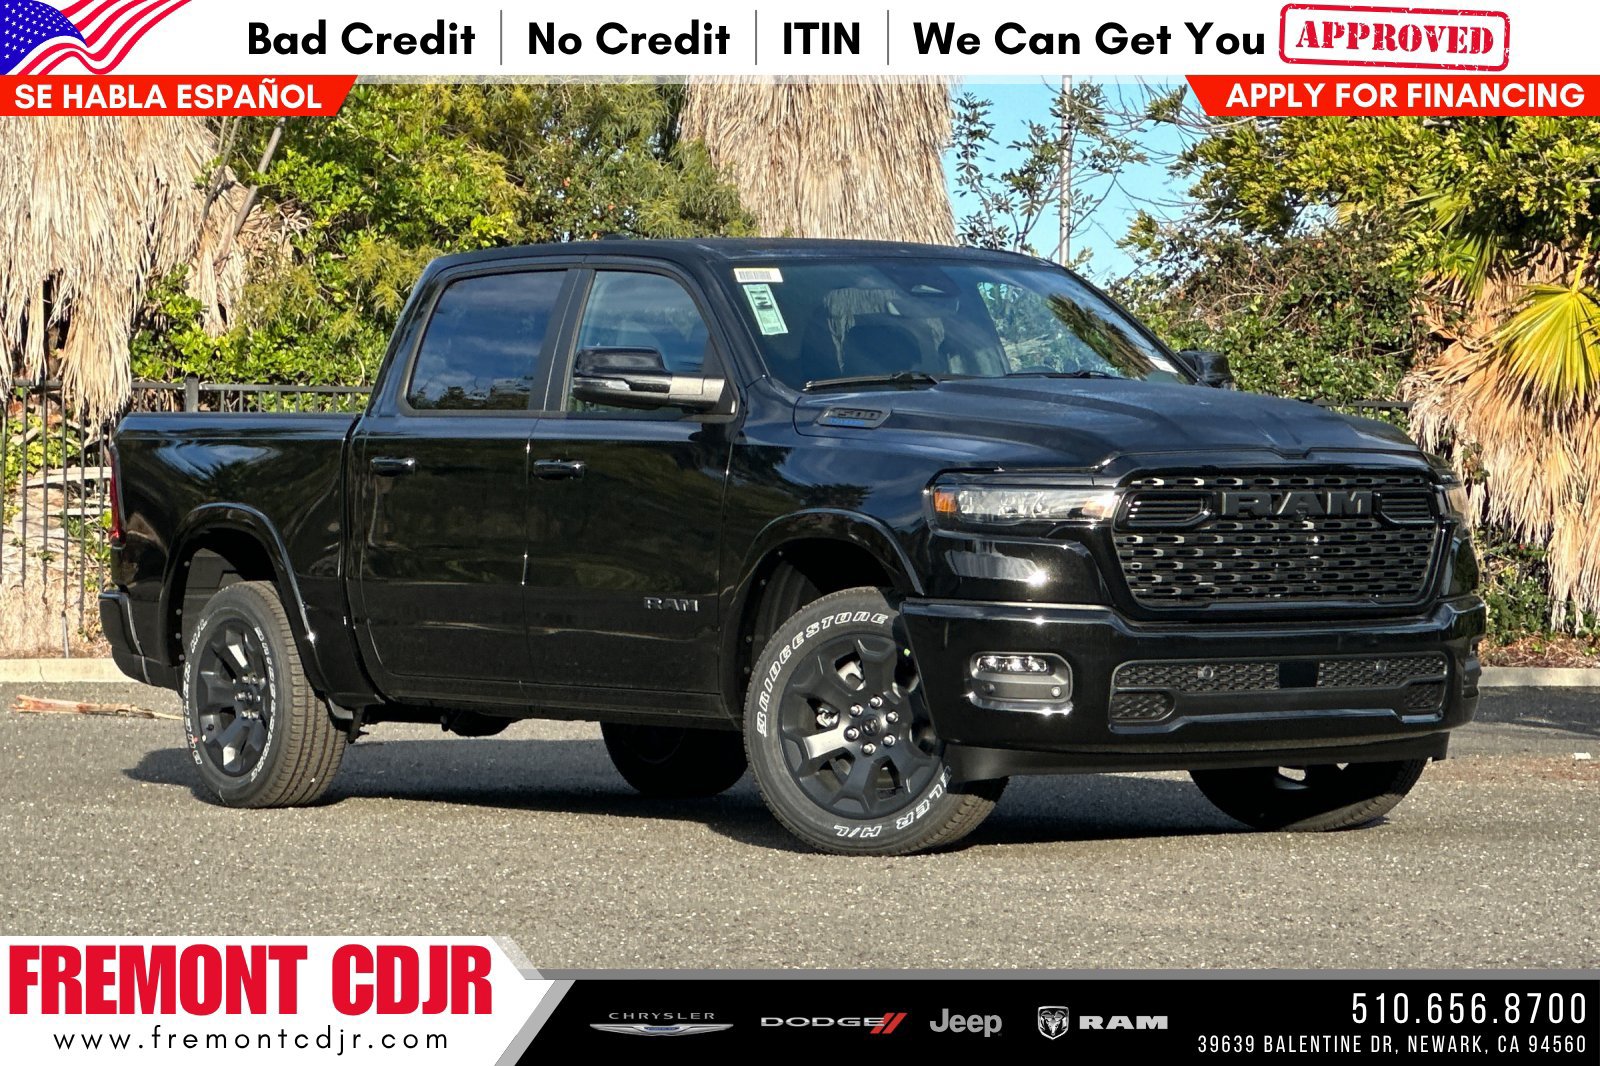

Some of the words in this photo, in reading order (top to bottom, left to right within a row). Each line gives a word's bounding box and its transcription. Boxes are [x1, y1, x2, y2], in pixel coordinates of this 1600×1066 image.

[1221, 491, 1372, 516] RAM
[643, 596, 698, 612] RAM
[756, 611, 889, 737] BRIDGESTONE
[833, 825, 882, 838] H/L
